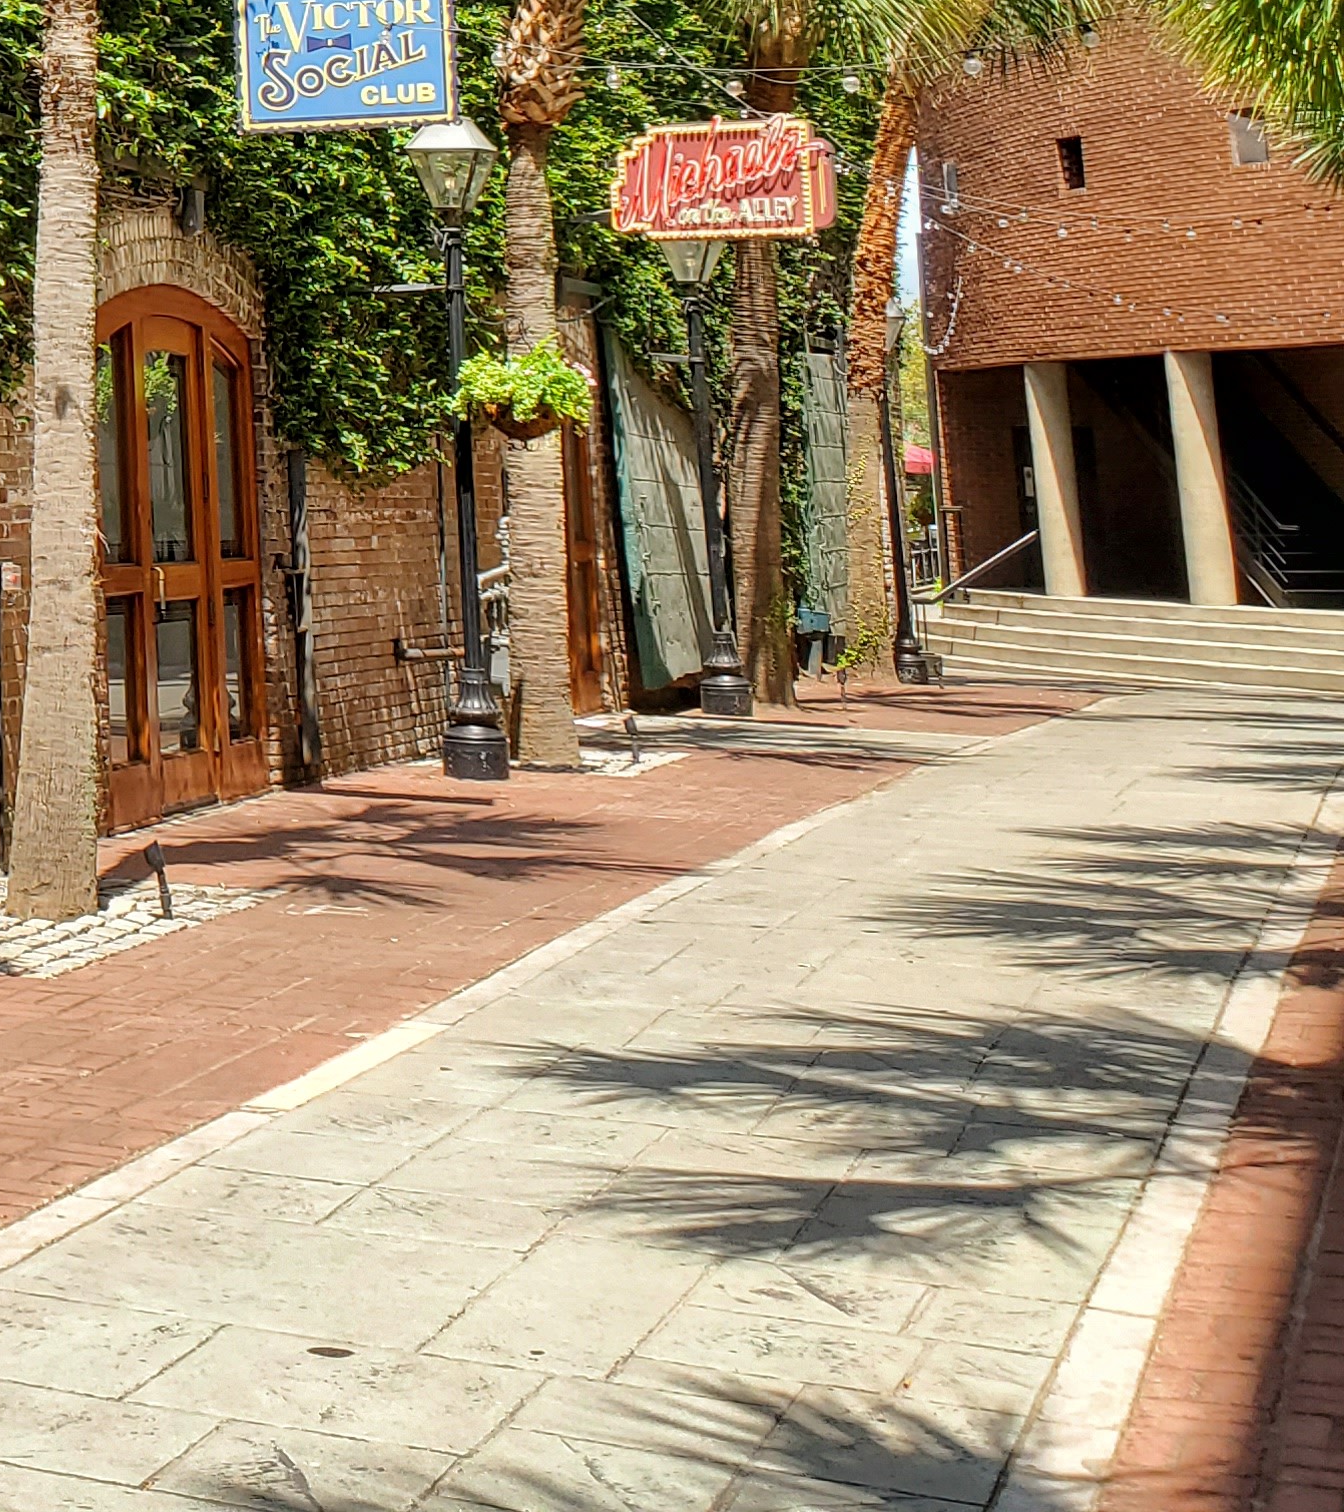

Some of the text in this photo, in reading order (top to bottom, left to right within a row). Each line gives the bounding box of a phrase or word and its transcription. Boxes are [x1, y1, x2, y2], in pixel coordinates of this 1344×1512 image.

[257, 29, 427, 111] SOCIAL
[360, 82, 437, 105] CLUB
[738, 194, 800, 222] ALLEY
